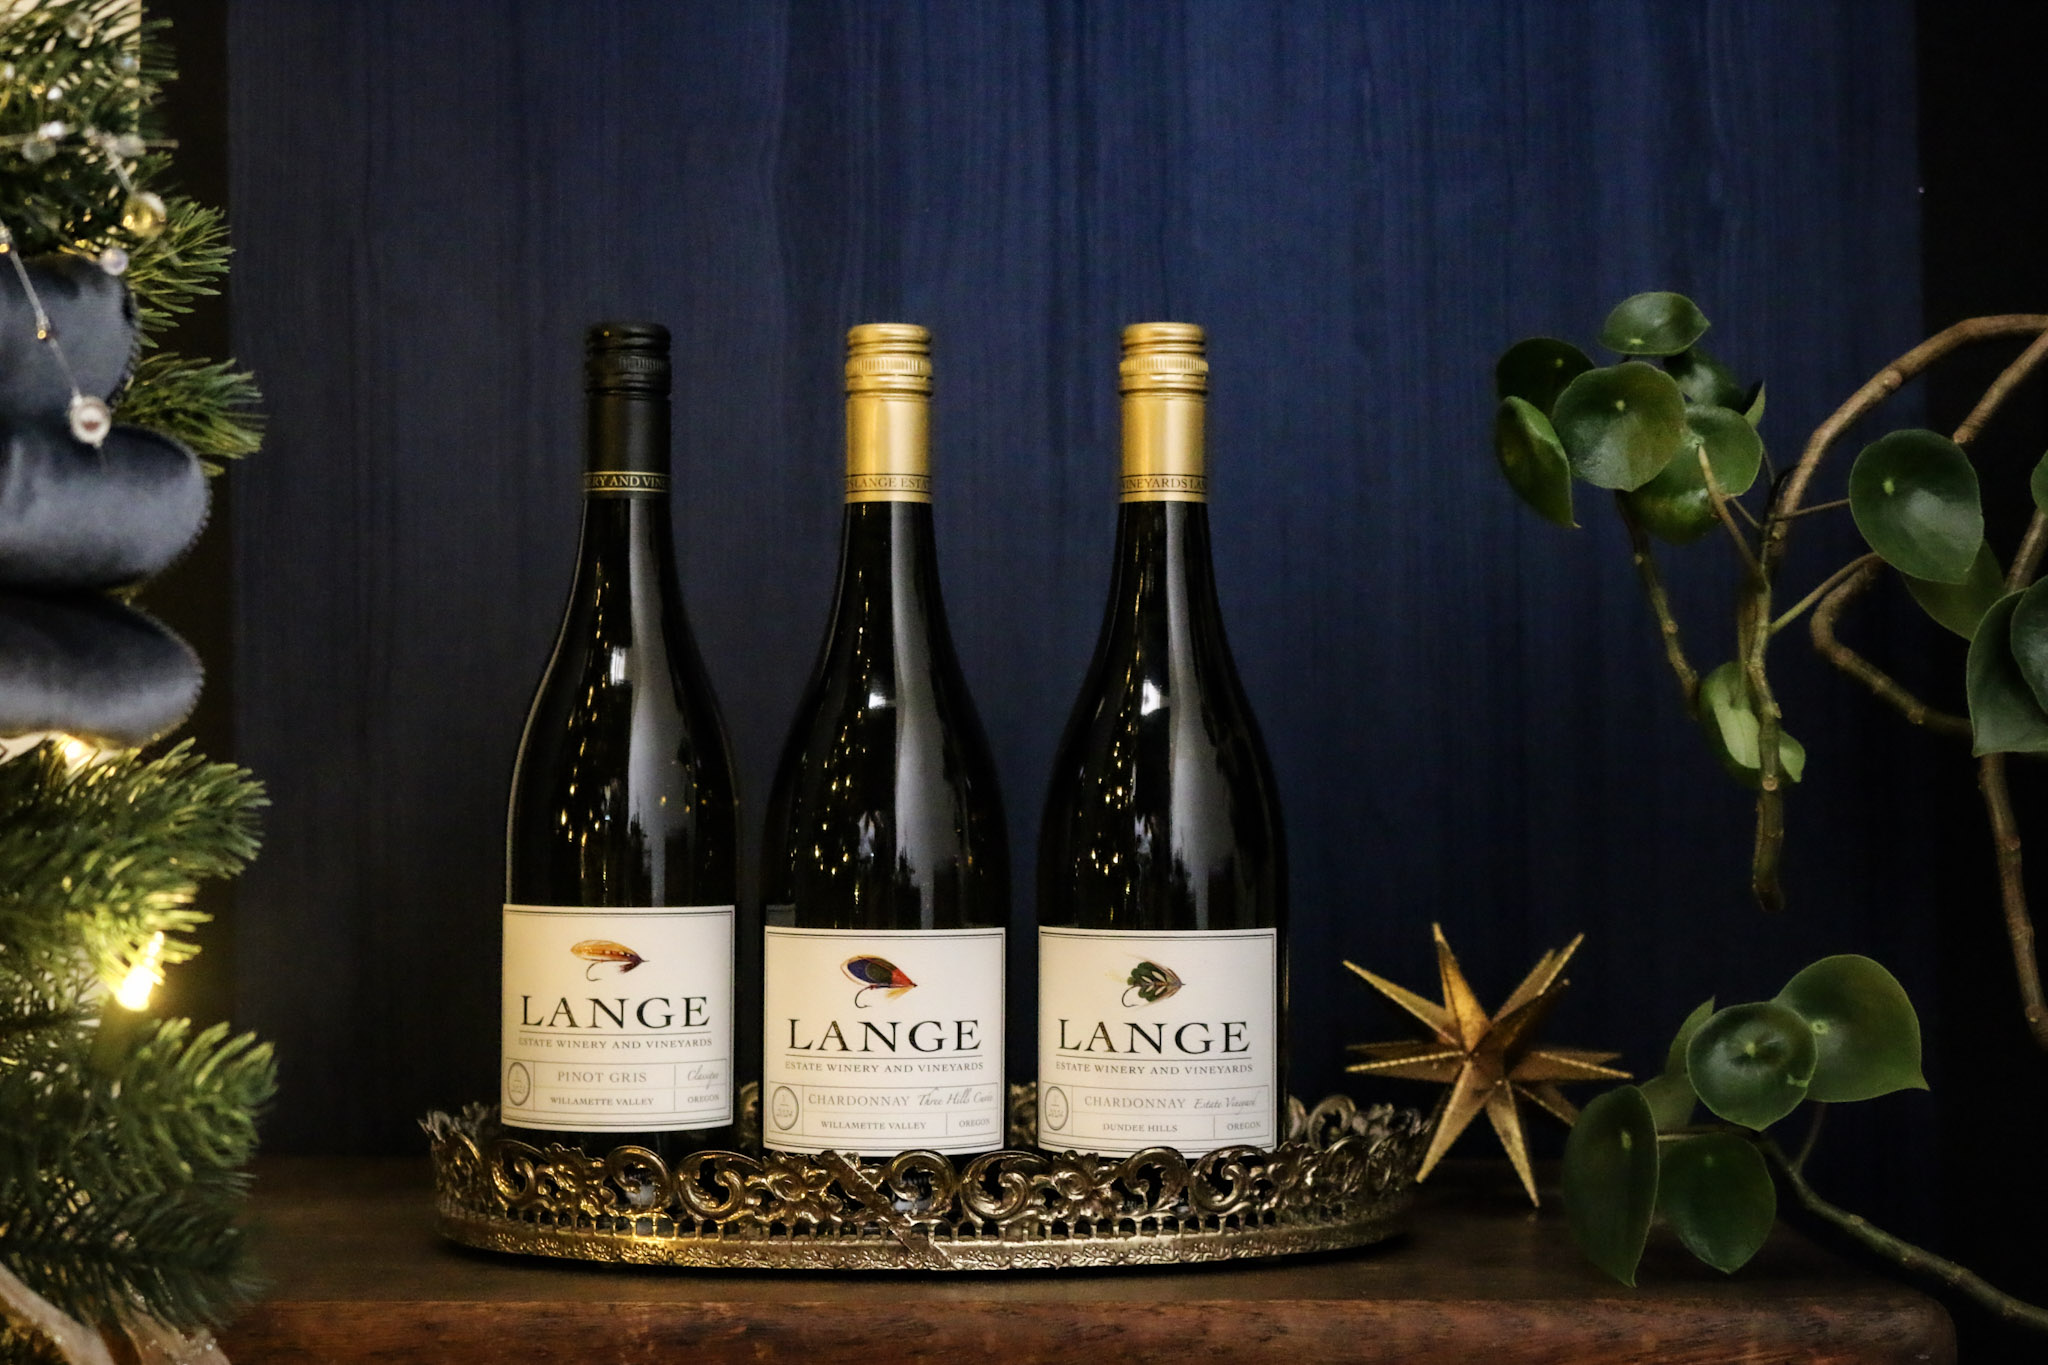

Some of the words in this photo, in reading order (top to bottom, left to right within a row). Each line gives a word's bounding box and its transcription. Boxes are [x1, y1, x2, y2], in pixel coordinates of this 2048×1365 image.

[609, 475, 640, 487] AND
[521, 995, 711, 1029] LANGE
[787, 1018, 982, 1053] LANGE
[1058, 1018, 1251, 1055] LANGE
[518, 1038, 553, 1048] ESTATE
[556, 1039, 607, 1049] WINERY
[612, 1039, 642, 1049] AND
[644, 1038, 713, 1049] VINEYARDS
[785, 1061, 823, 1072] ESTATE
[827, 1063, 880, 1073] WINERY
[884, 1064, 914, 1073] AND
[918, 1062, 984, 1073] VINEYARDS
[1056, 1061, 1091, 1073] ESTATE
[1095, 1063, 1146, 1075] WINERY
[1150, 1065, 1180, 1075] AND
[1184, 1063, 1254, 1075] VINEYARDS
[557, 1071, 605, 1083] PINOT
[609, 1072, 648, 1083] GRIS
[550, 1096, 615, 1106] WILLAMETTE
[615, 1097, 655, 1106] VALLEY
[687, 1094, 720, 1104] OREGON
[808, 1093, 911, 1107] CHARDONNAY
[1084, 1096, 1187, 1110] CHARDONNAY
[1193, 1098, 1223, 1110] Estate
[820, 1120, 886, 1131] WILLAMETTE
[887, 1121, 927, 1131] VALLEY
[958, 1118, 991, 1128] OREGON
[1102, 1122, 1146, 1133] DUNDEE
[1148, 1123, 1179, 1134] HILLS
[1226, 1121, 1261, 1131] OREGON
